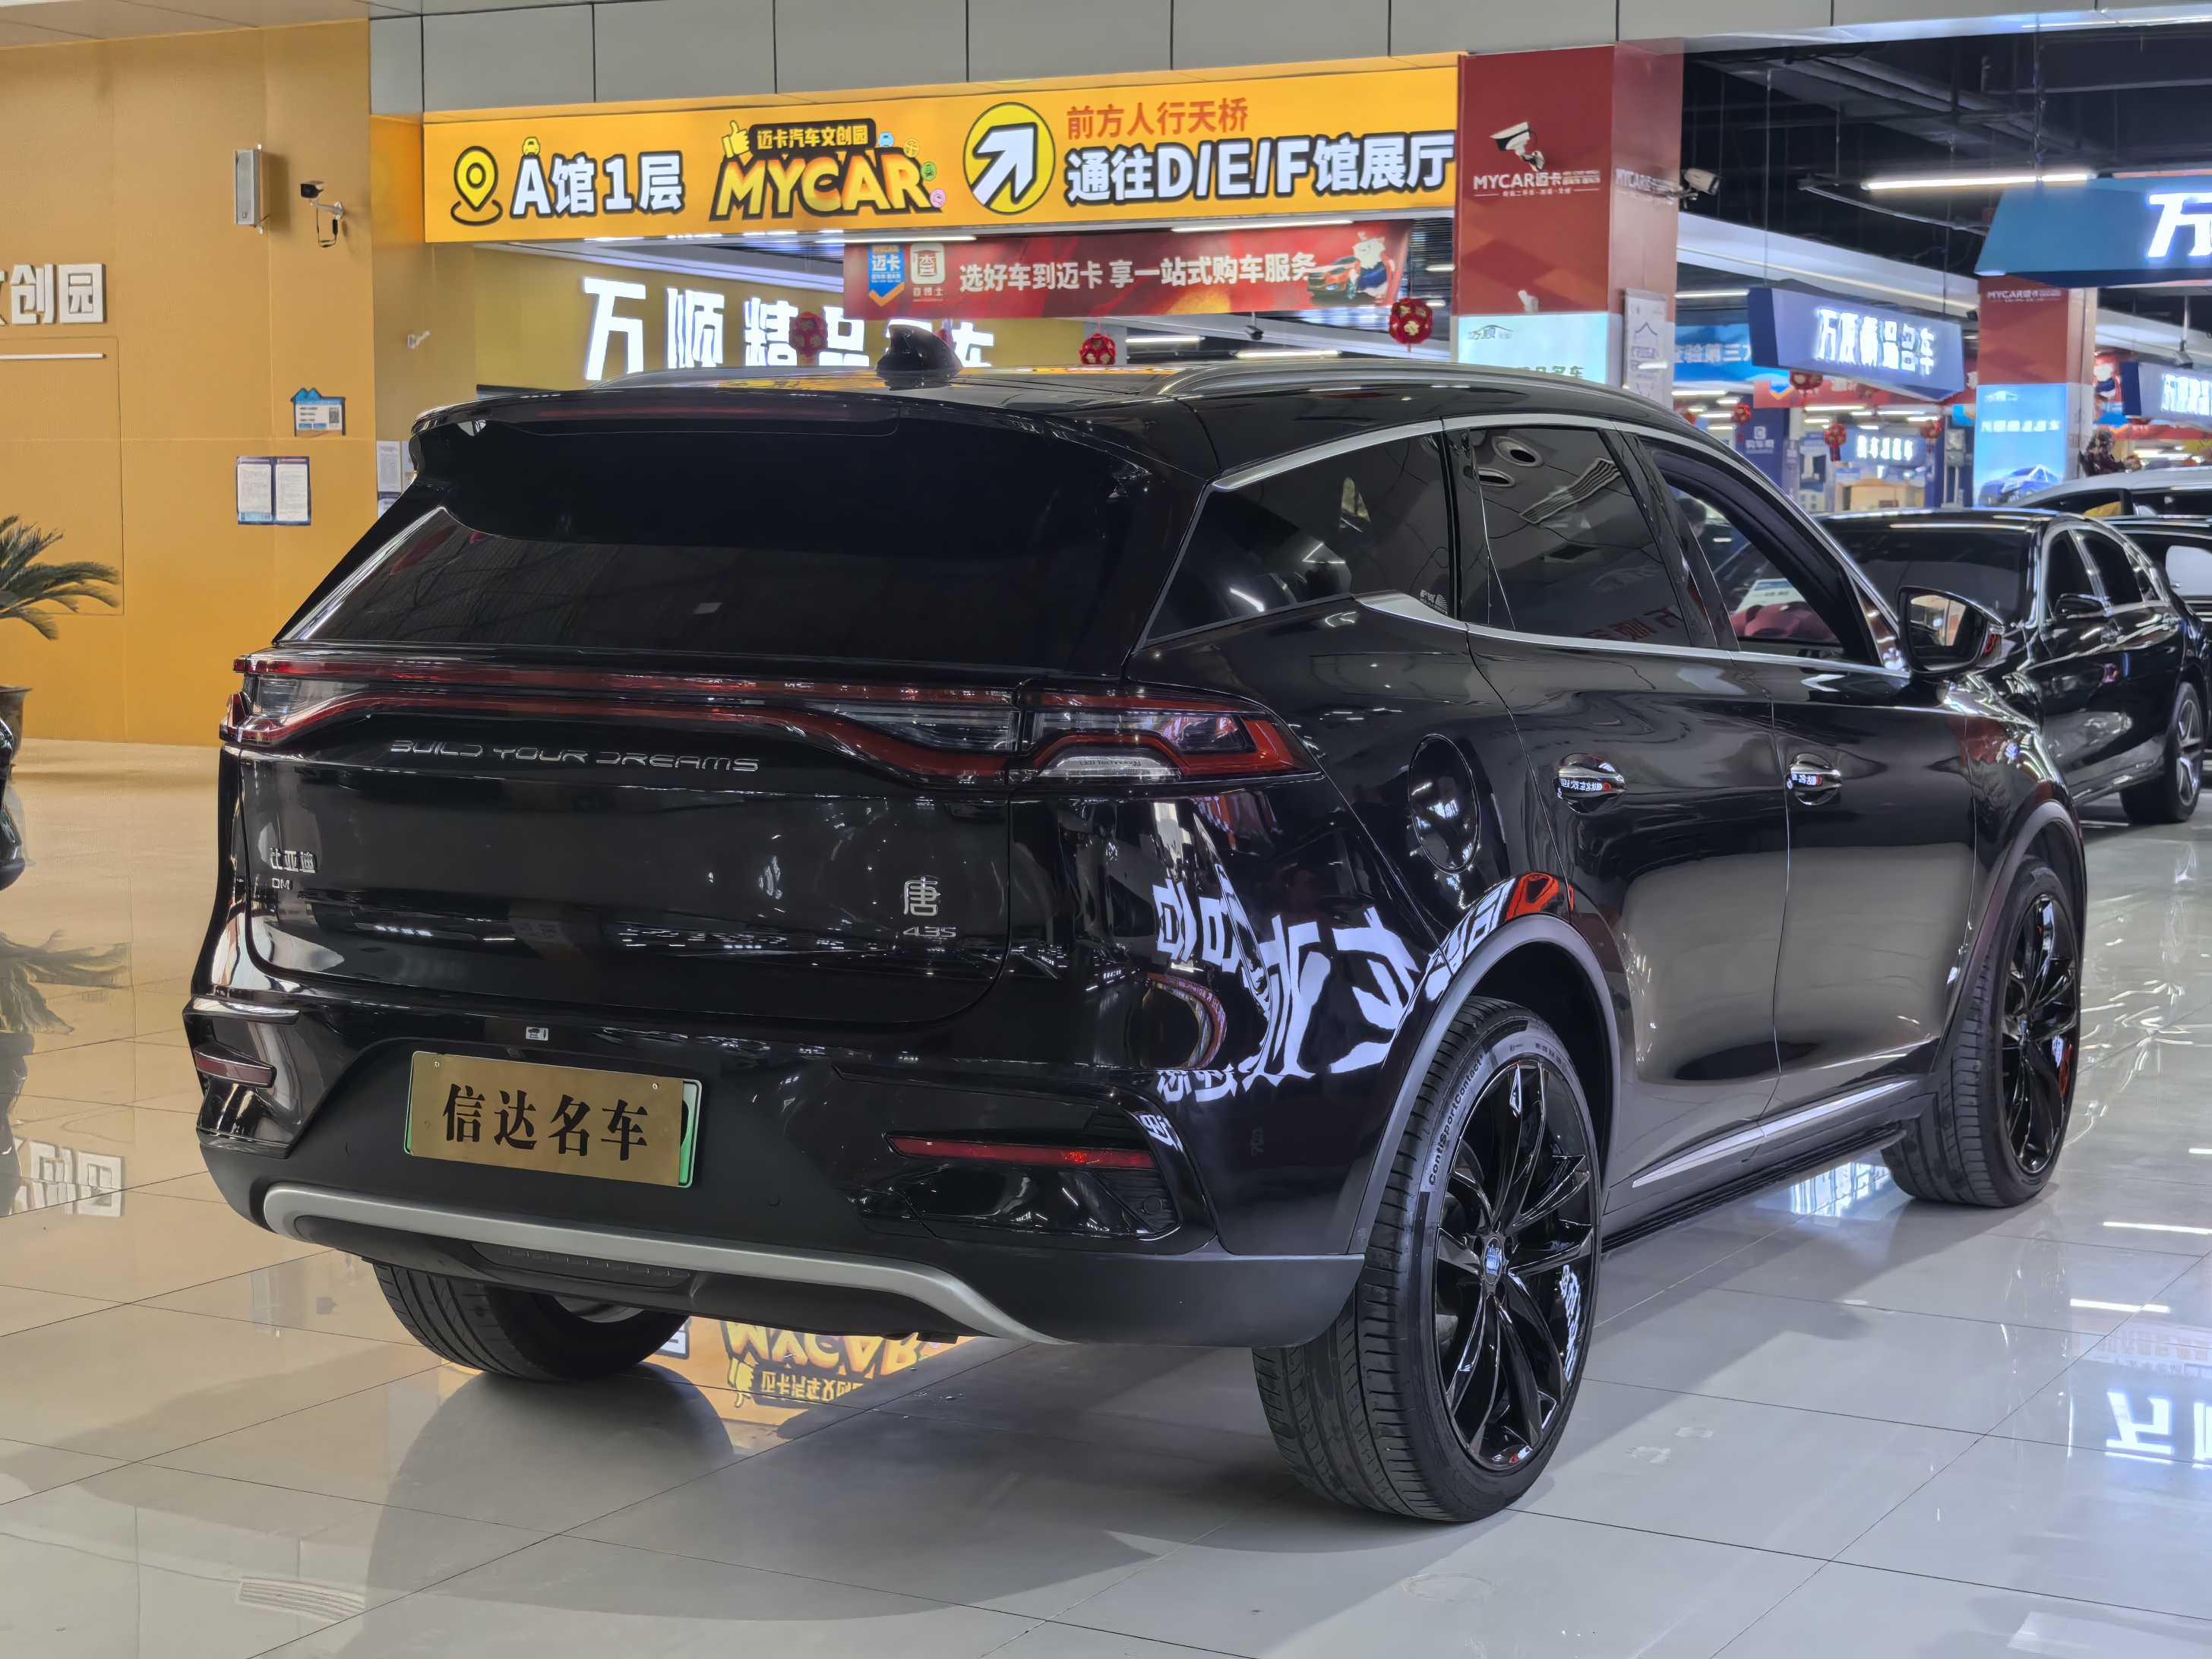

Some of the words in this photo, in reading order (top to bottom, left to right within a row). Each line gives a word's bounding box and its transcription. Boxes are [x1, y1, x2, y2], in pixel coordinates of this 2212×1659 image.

[756, 124, 869, 150] 迈卡汽车文创园
[1066, 97, 1250, 141] 前方人行天桥
[511, 152, 684, 217] A馆1层
[712, 150, 935, 219] MYCAR
[1066, 131, 1455, 205] 通往D/E/F馆展厅
[0, 264, 105, 326] 创园
[959, 259, 1103, 293] 选好车到迈卡
[1108, 251, 1316, 288] 享一站式购车服务
[583, 275, 995, 381] 万顺精品
[390, 740, 483, 757] BUILD
[493, 747, 589, 763] YOUR
[596, 751, 760, 772] DREAMS
[441, 1082, 649, 1162] 信达名车
